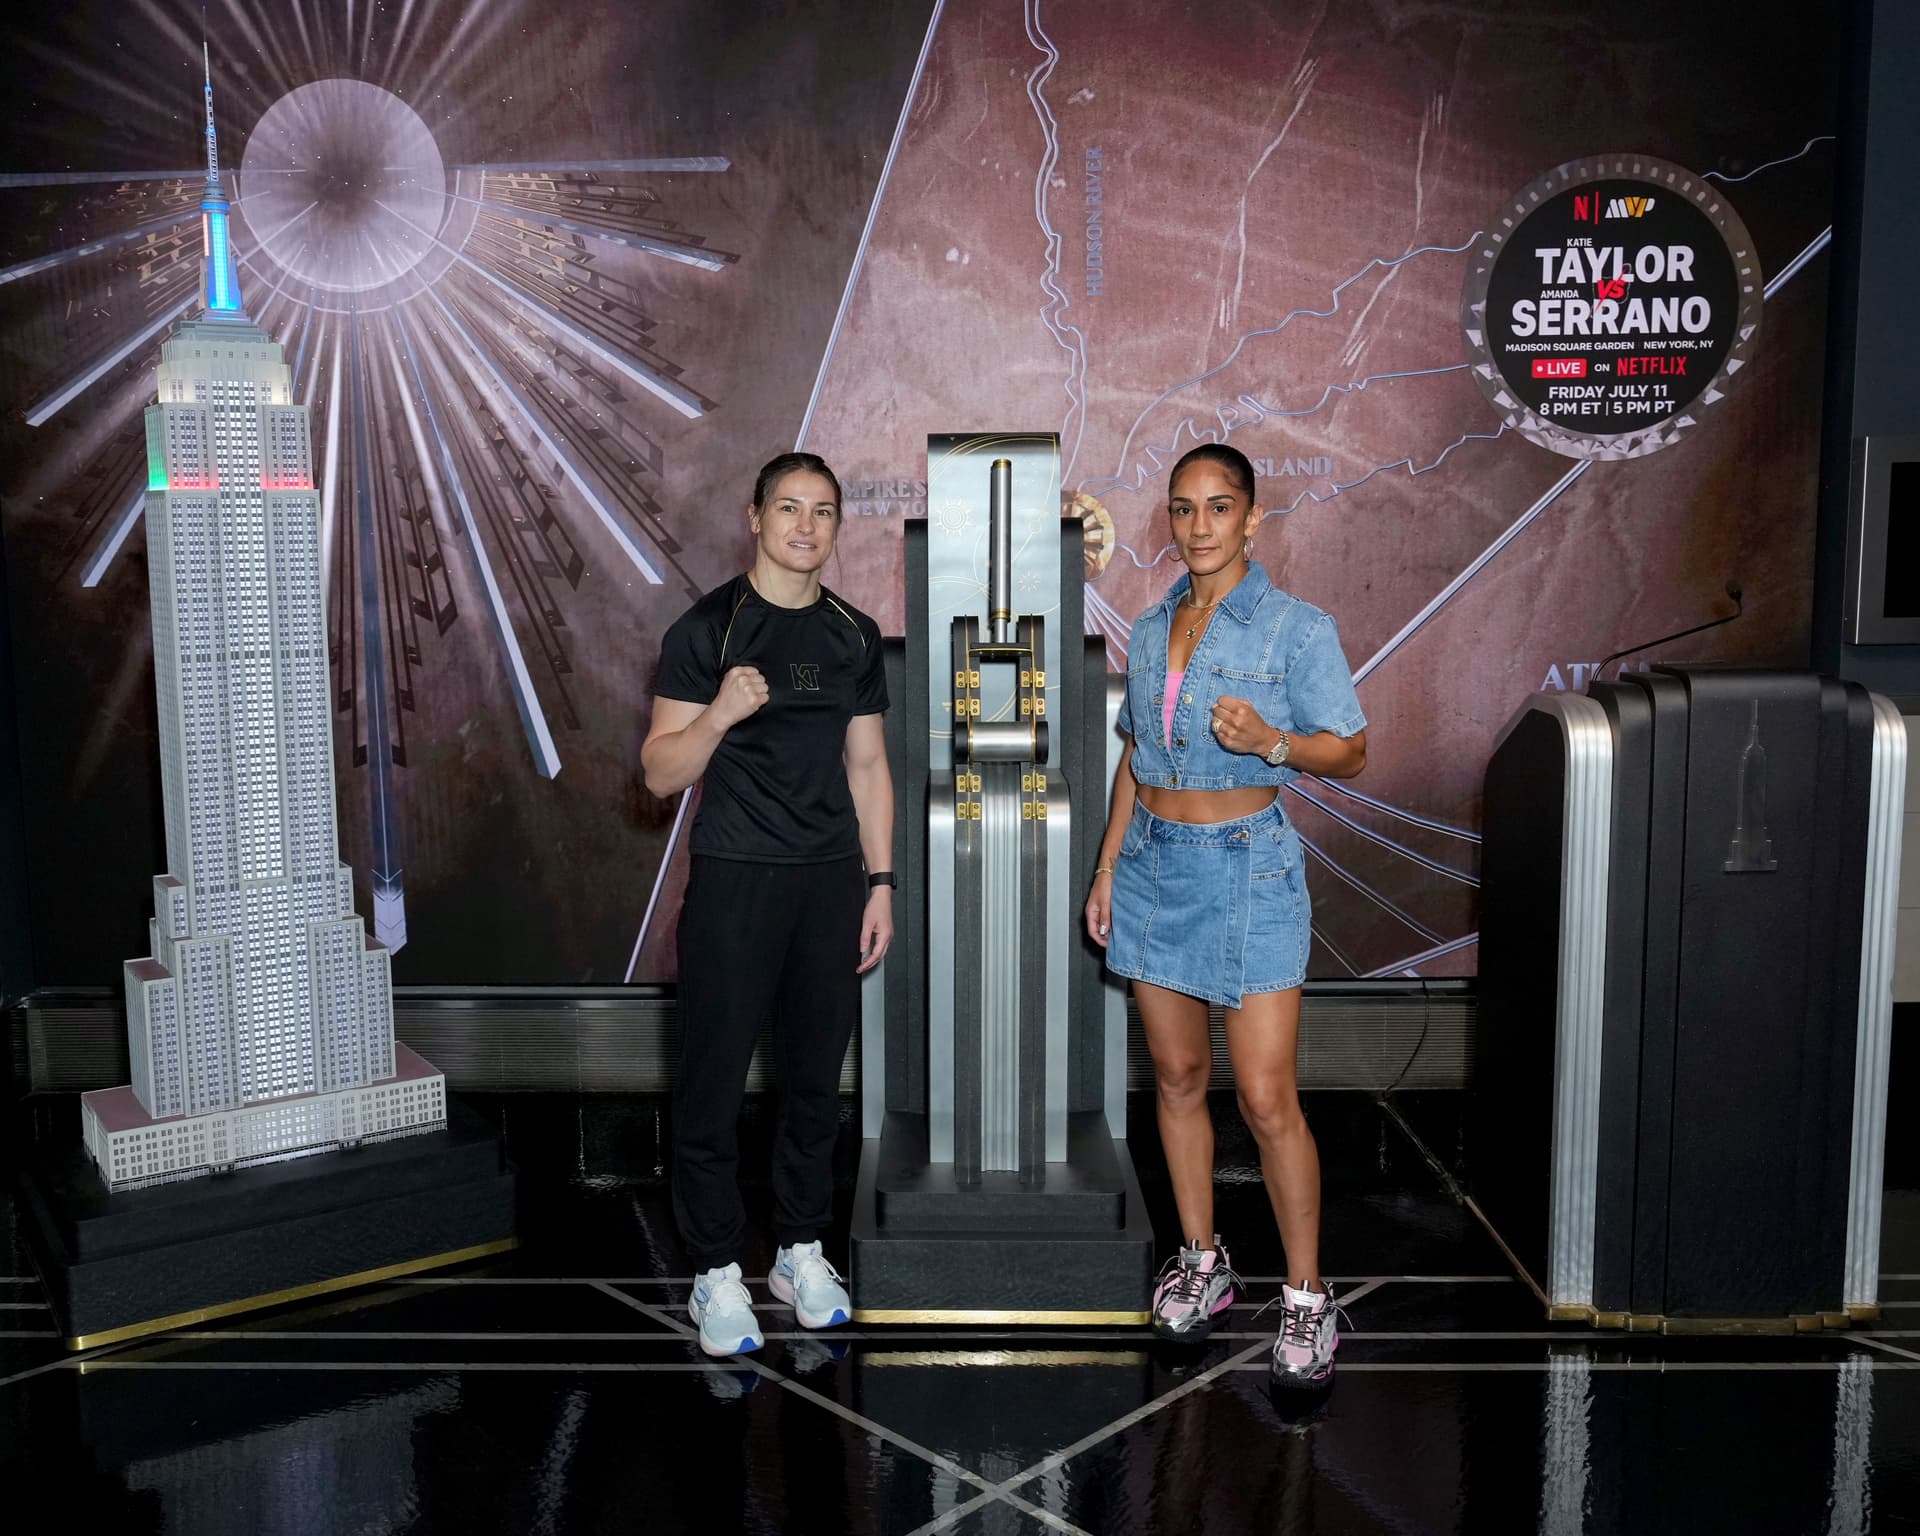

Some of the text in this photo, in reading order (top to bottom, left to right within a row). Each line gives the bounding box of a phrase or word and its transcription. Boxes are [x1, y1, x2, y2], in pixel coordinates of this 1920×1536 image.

[1574, 195, 1656, 221] N MVP
[1086, 145, 1104, 296] HUDSON RIVER
[1566, 237, 1593, 247] KATIE
[1535, 245, 1694, 284] TAYLOR
[1540, 289, 1579, 299] AMANDA
[1596, 278, 1627, 299] VS
[1511, 296, 1711, 337] SERRANO
[1505, 339, 1714, 352] MADISON SQUARE GARDEN NEW YORK, NY
[1547, 356, 1688, 376] LIVE ON NETFLIX
[1549, 384, 1668, 399] FRIDAY JULY 11
[1539, 403, 1550, 416] 8
[1553, 403, 1577, 415] PM
[1581, 402, 1601, 414] ET
[1613, 401, 1623, 415] 5
[1626, 401, 1650, 414] PM
[1654, 400, 1675, 413] PT
[1251, 456, 1333, 477] SLAND
[841, 479, 911, 498] MPIRE
[899, 500, 927, 516] YO
[789, 663, 820, 690] KT
